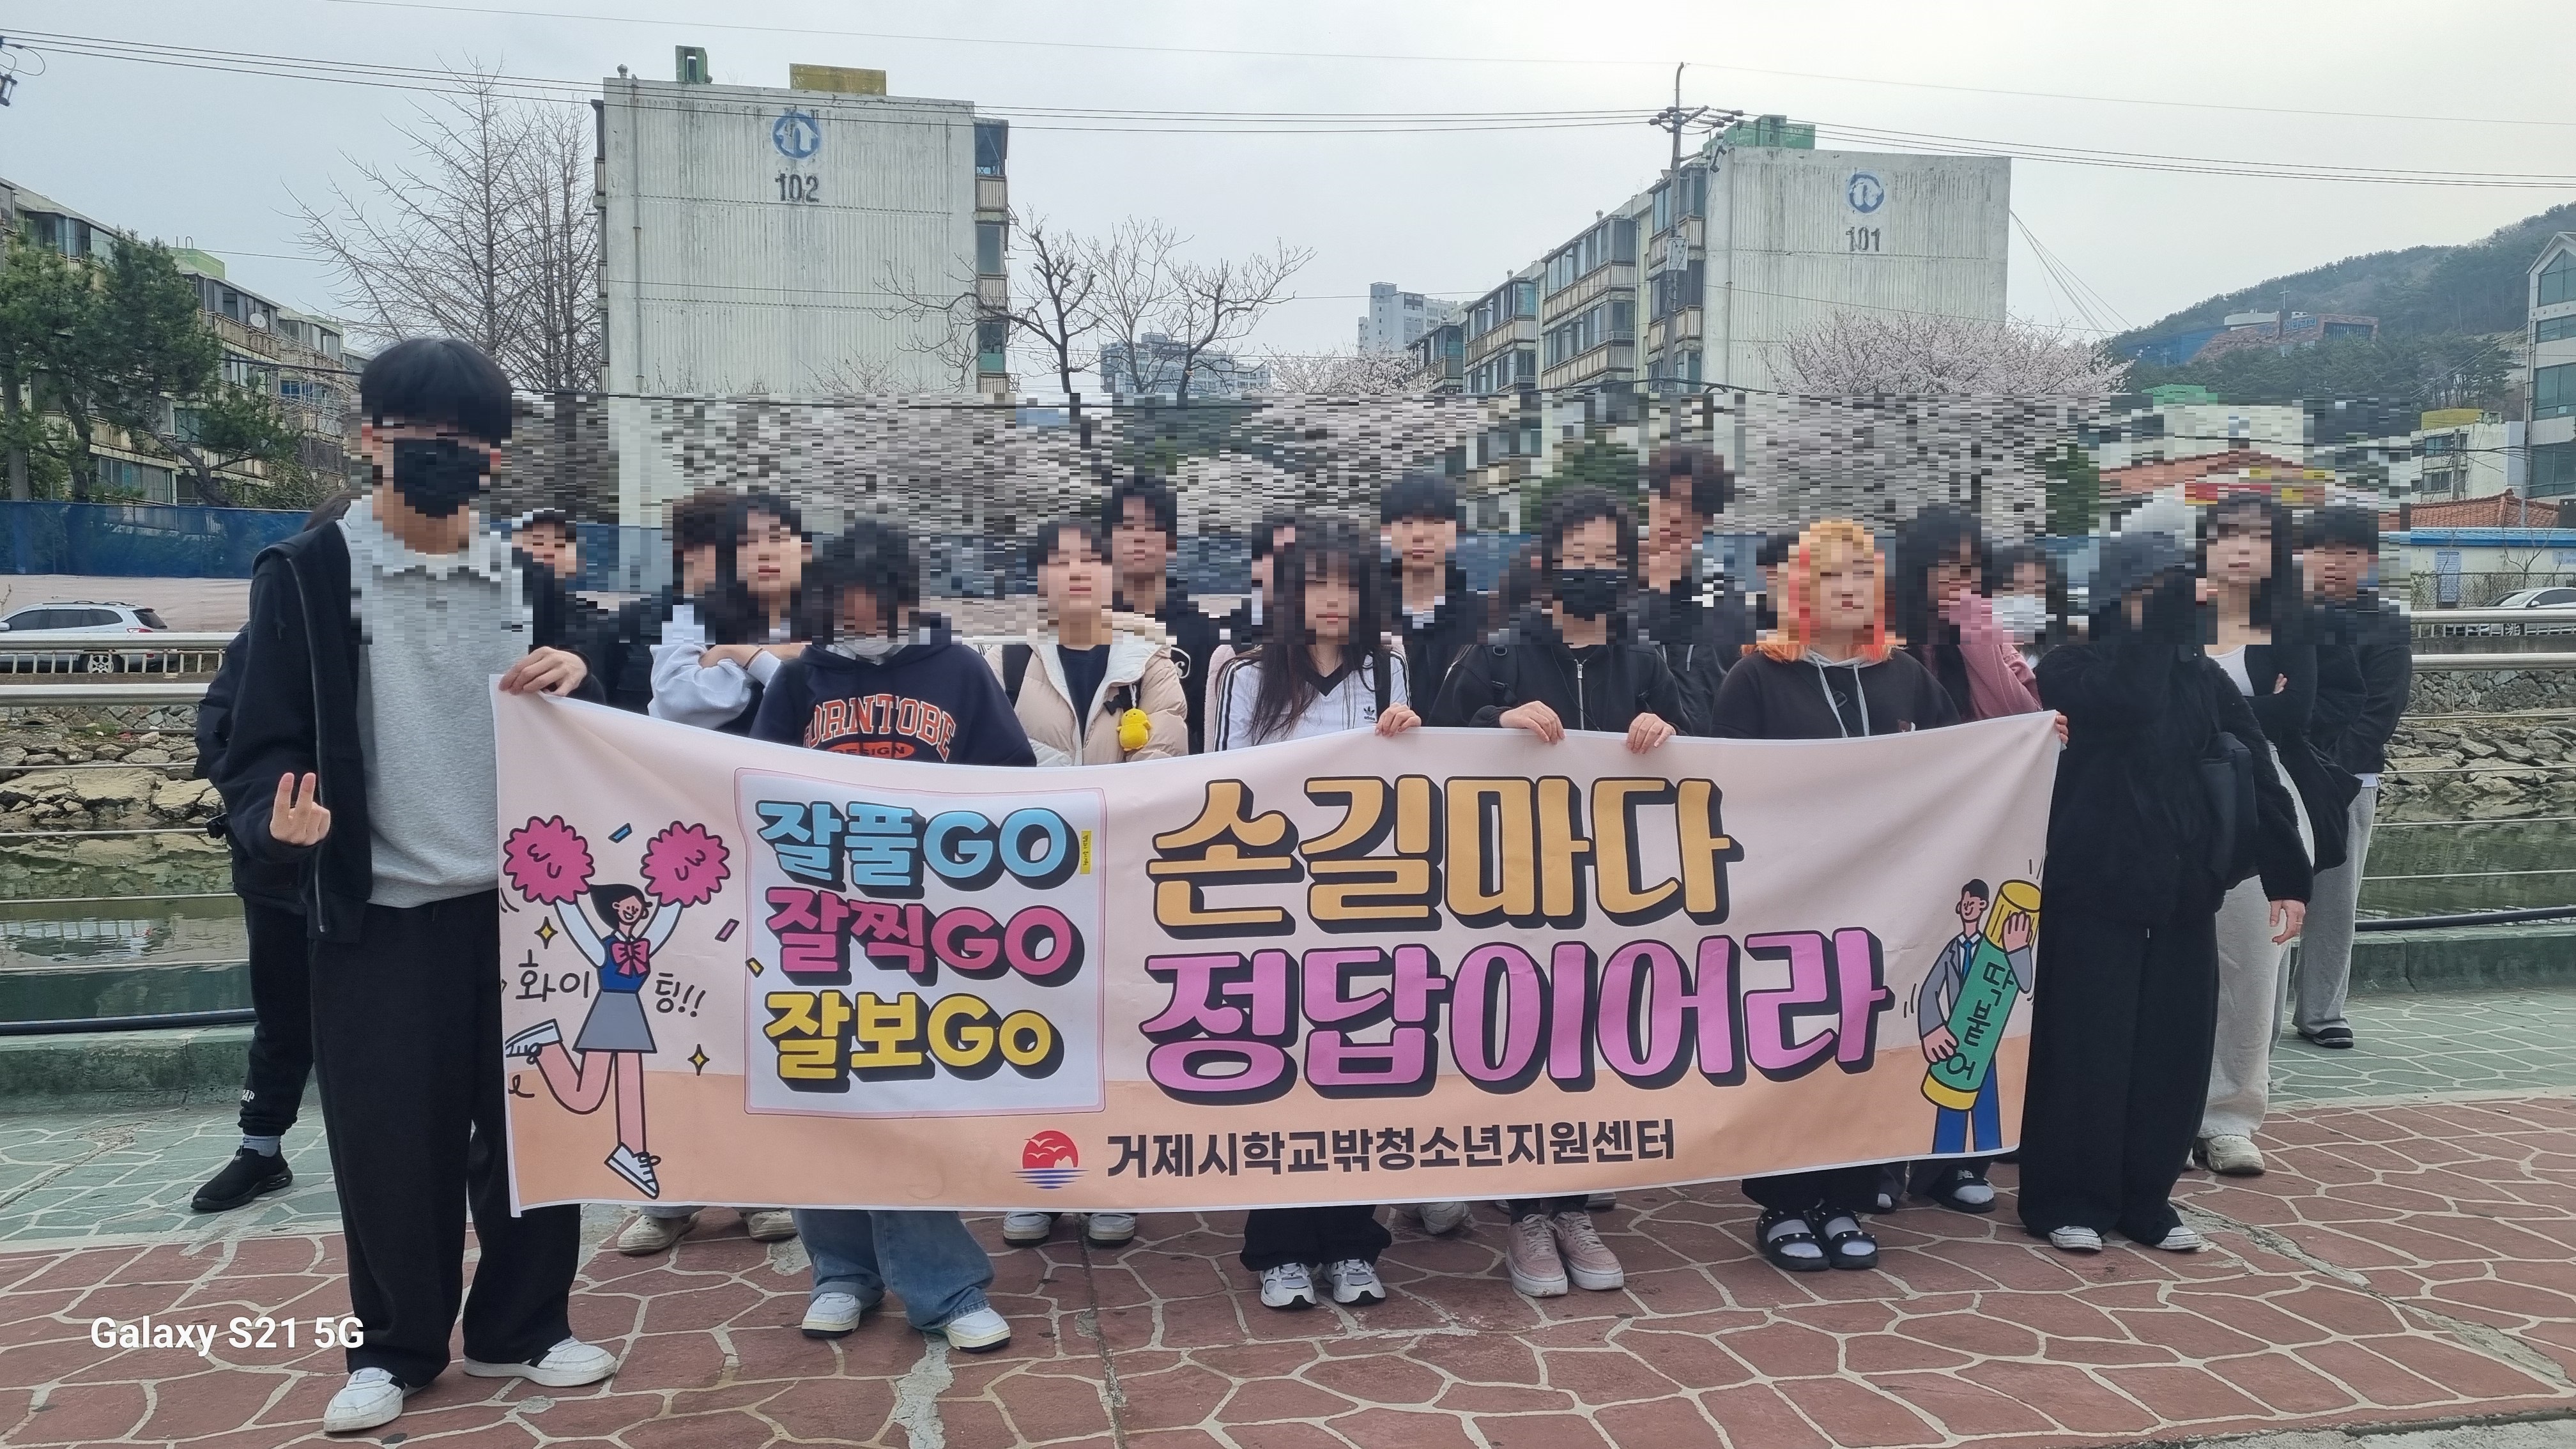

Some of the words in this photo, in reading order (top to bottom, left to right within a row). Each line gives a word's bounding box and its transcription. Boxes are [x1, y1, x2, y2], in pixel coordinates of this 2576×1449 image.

[774, 173, 820, 203] 102
[1845, 226, 1880, 252] 101
[803, 693, 956, 763] ORNTOBE
[756, 800, 1080, 900] 잘풀GO
[1147, 775, 1744, 939] 손길마다
[765, 887, 1086, 988] 잘찍GO
[1138, 927, 1896, 1106] 정답이어라
[240, 1088, 255, 1103] AP
[1107, 1119, 1675, 1179] 거제시학교밖청소년지원센터
